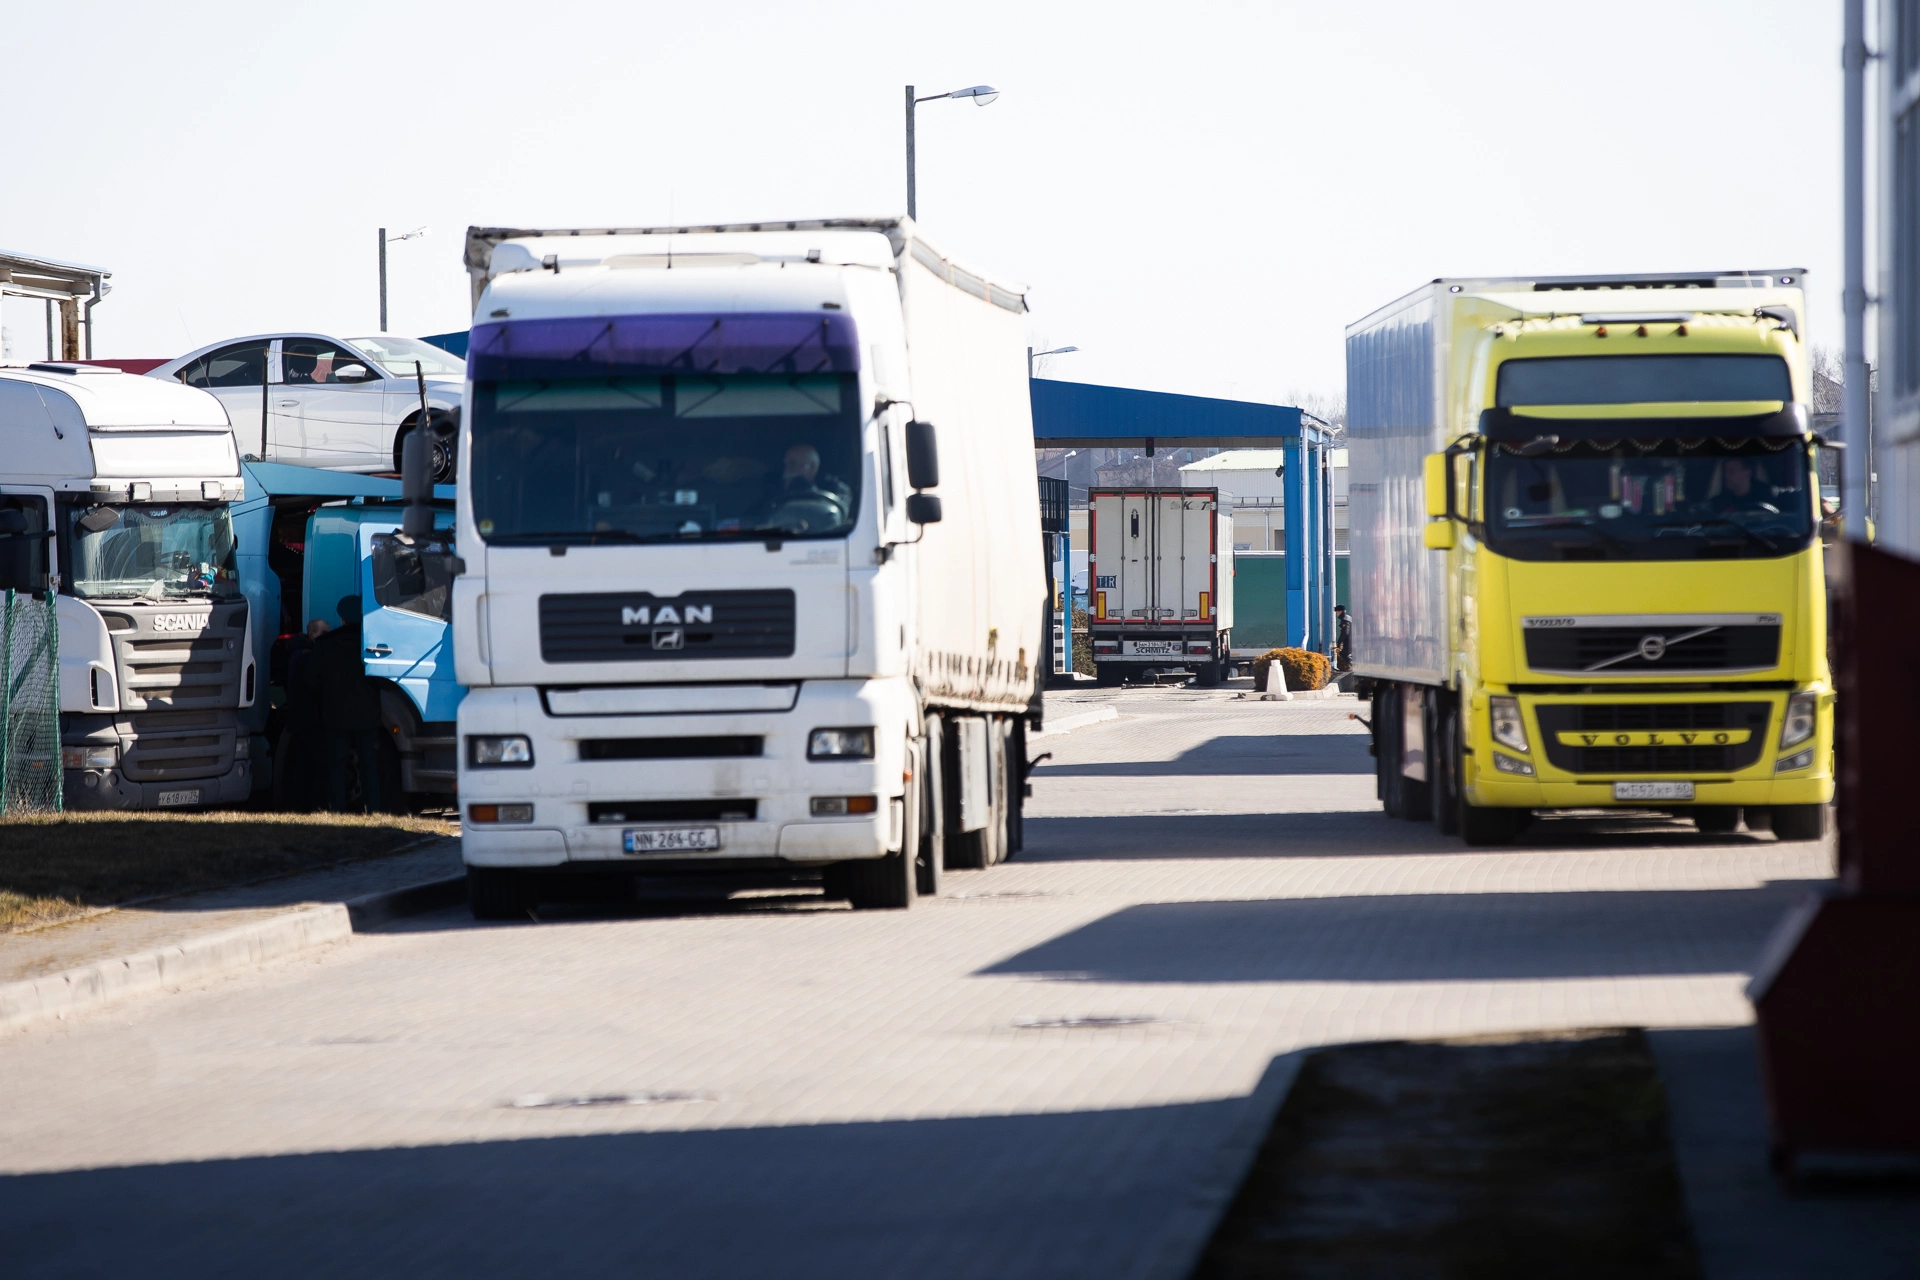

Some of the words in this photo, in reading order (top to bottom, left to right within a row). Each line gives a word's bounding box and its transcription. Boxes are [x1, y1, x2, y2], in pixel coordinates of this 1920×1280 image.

[1097, 576, 1115, 588] TIR
[622, 604, 713, 625] MAN
[153, 613, 210, 631] SCANIA
[1527, 618, 1576, 627] VOLVO
[1580, 732, 1730, 746] VOLVO
